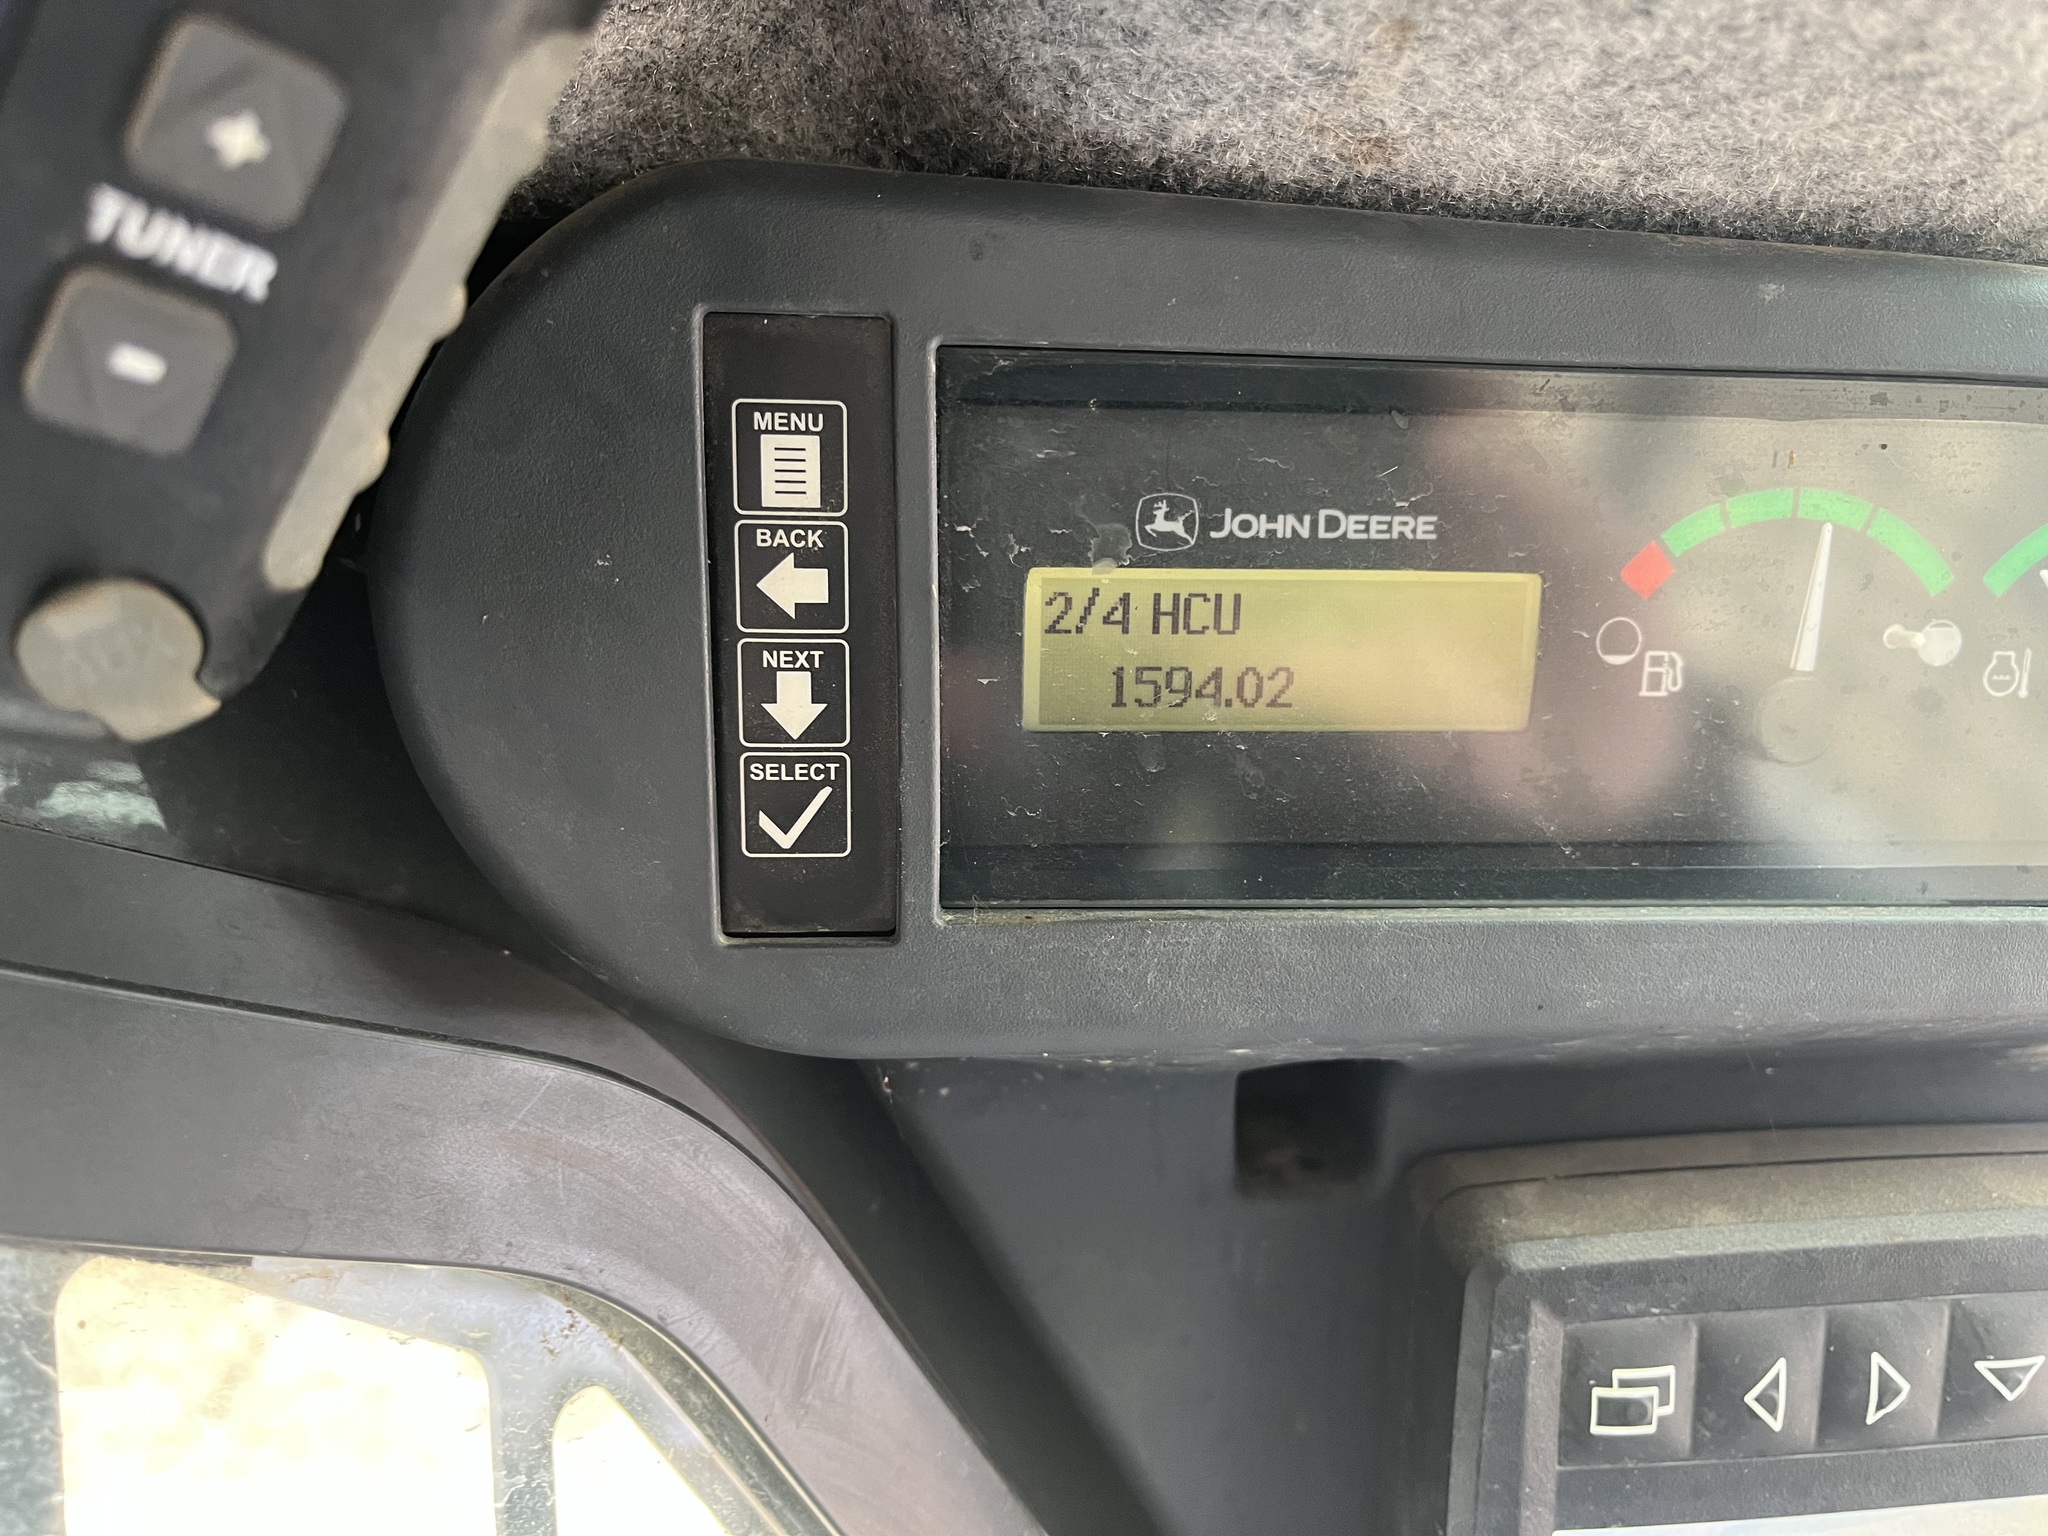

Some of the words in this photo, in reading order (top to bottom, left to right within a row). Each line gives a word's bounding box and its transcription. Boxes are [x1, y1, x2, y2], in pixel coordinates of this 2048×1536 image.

[753, 412, 824, 432] MENU
[1210, 508, 1310, 539] JOHN
[1318, 509, 1438, 540] DEERE
[756, 529, 824, 548] BACK
[1044, 588, 1130, 635] 2/4
[1152, 593, 1242, 635] HCU
[762, 650, 824, 669] NEXT
[1110, 666, 1294, 708] 1594.02
[749, 763, 840, 781] SELECT
